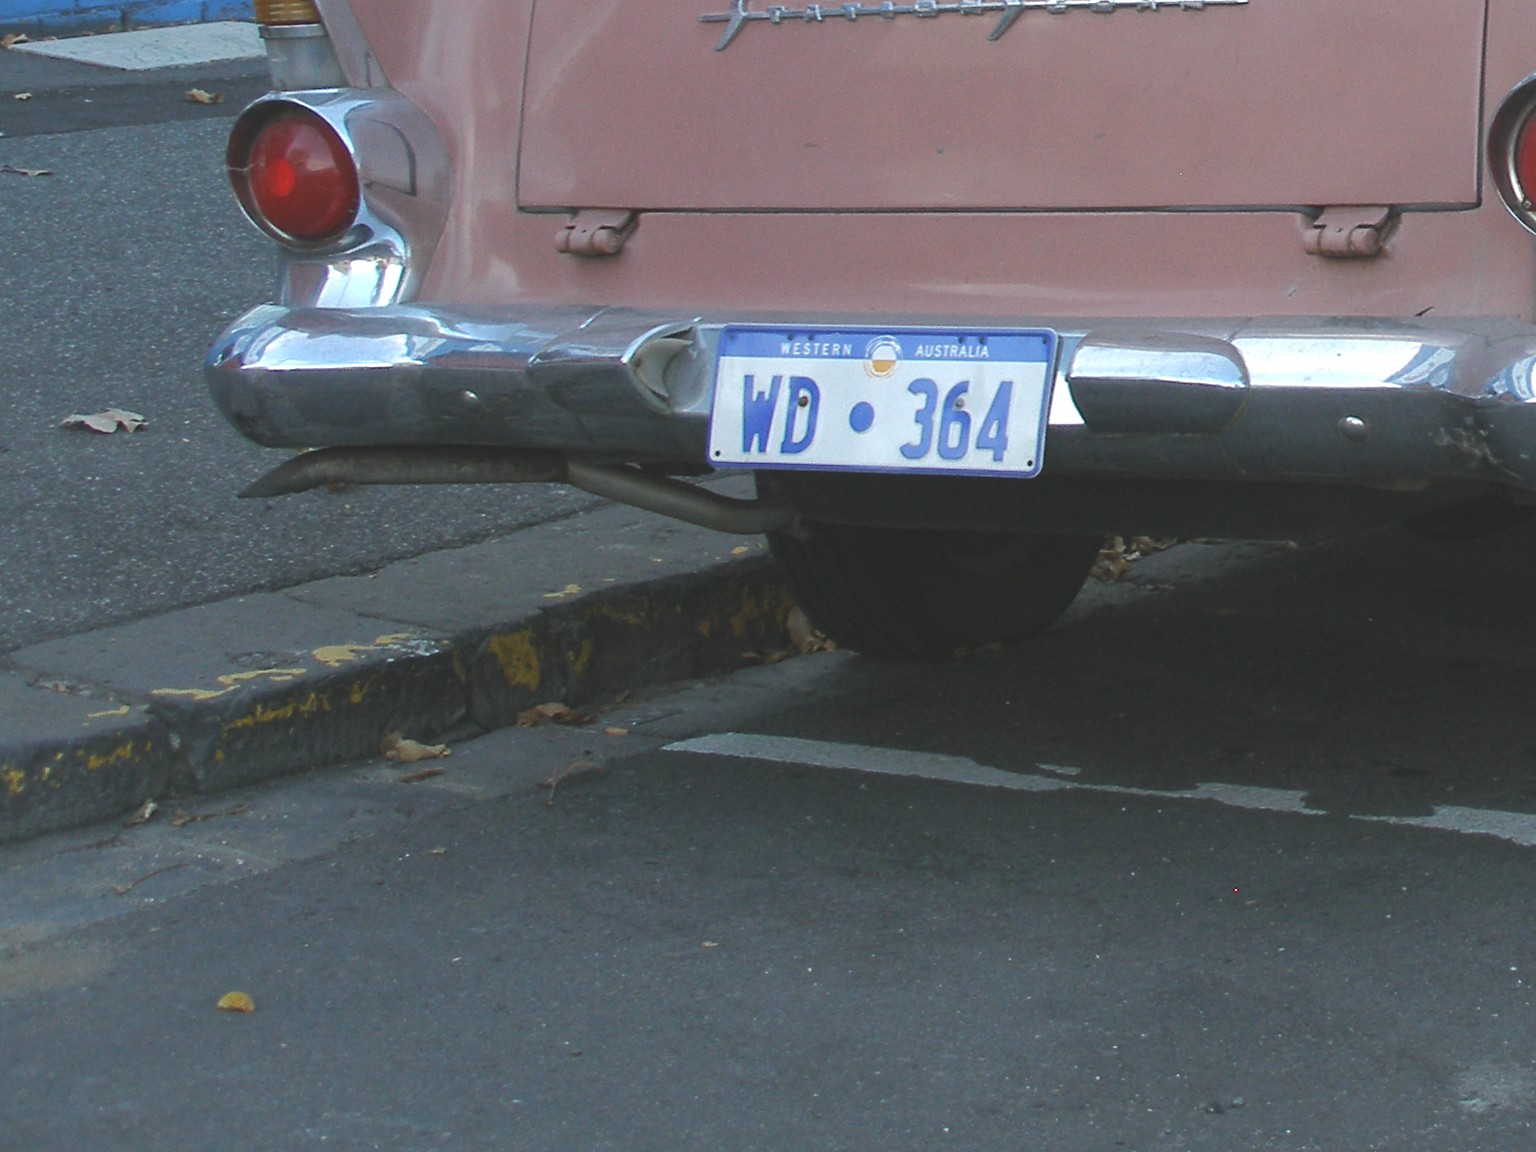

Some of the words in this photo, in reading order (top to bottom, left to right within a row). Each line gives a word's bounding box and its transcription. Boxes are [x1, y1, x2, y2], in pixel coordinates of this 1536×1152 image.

[780, 342, 852, 356] WESTERN
[914, 344, 990, 358] AUSTRALIA
[742, 374, 821, 455] WD
[899, 377, 1014, 462] 364
